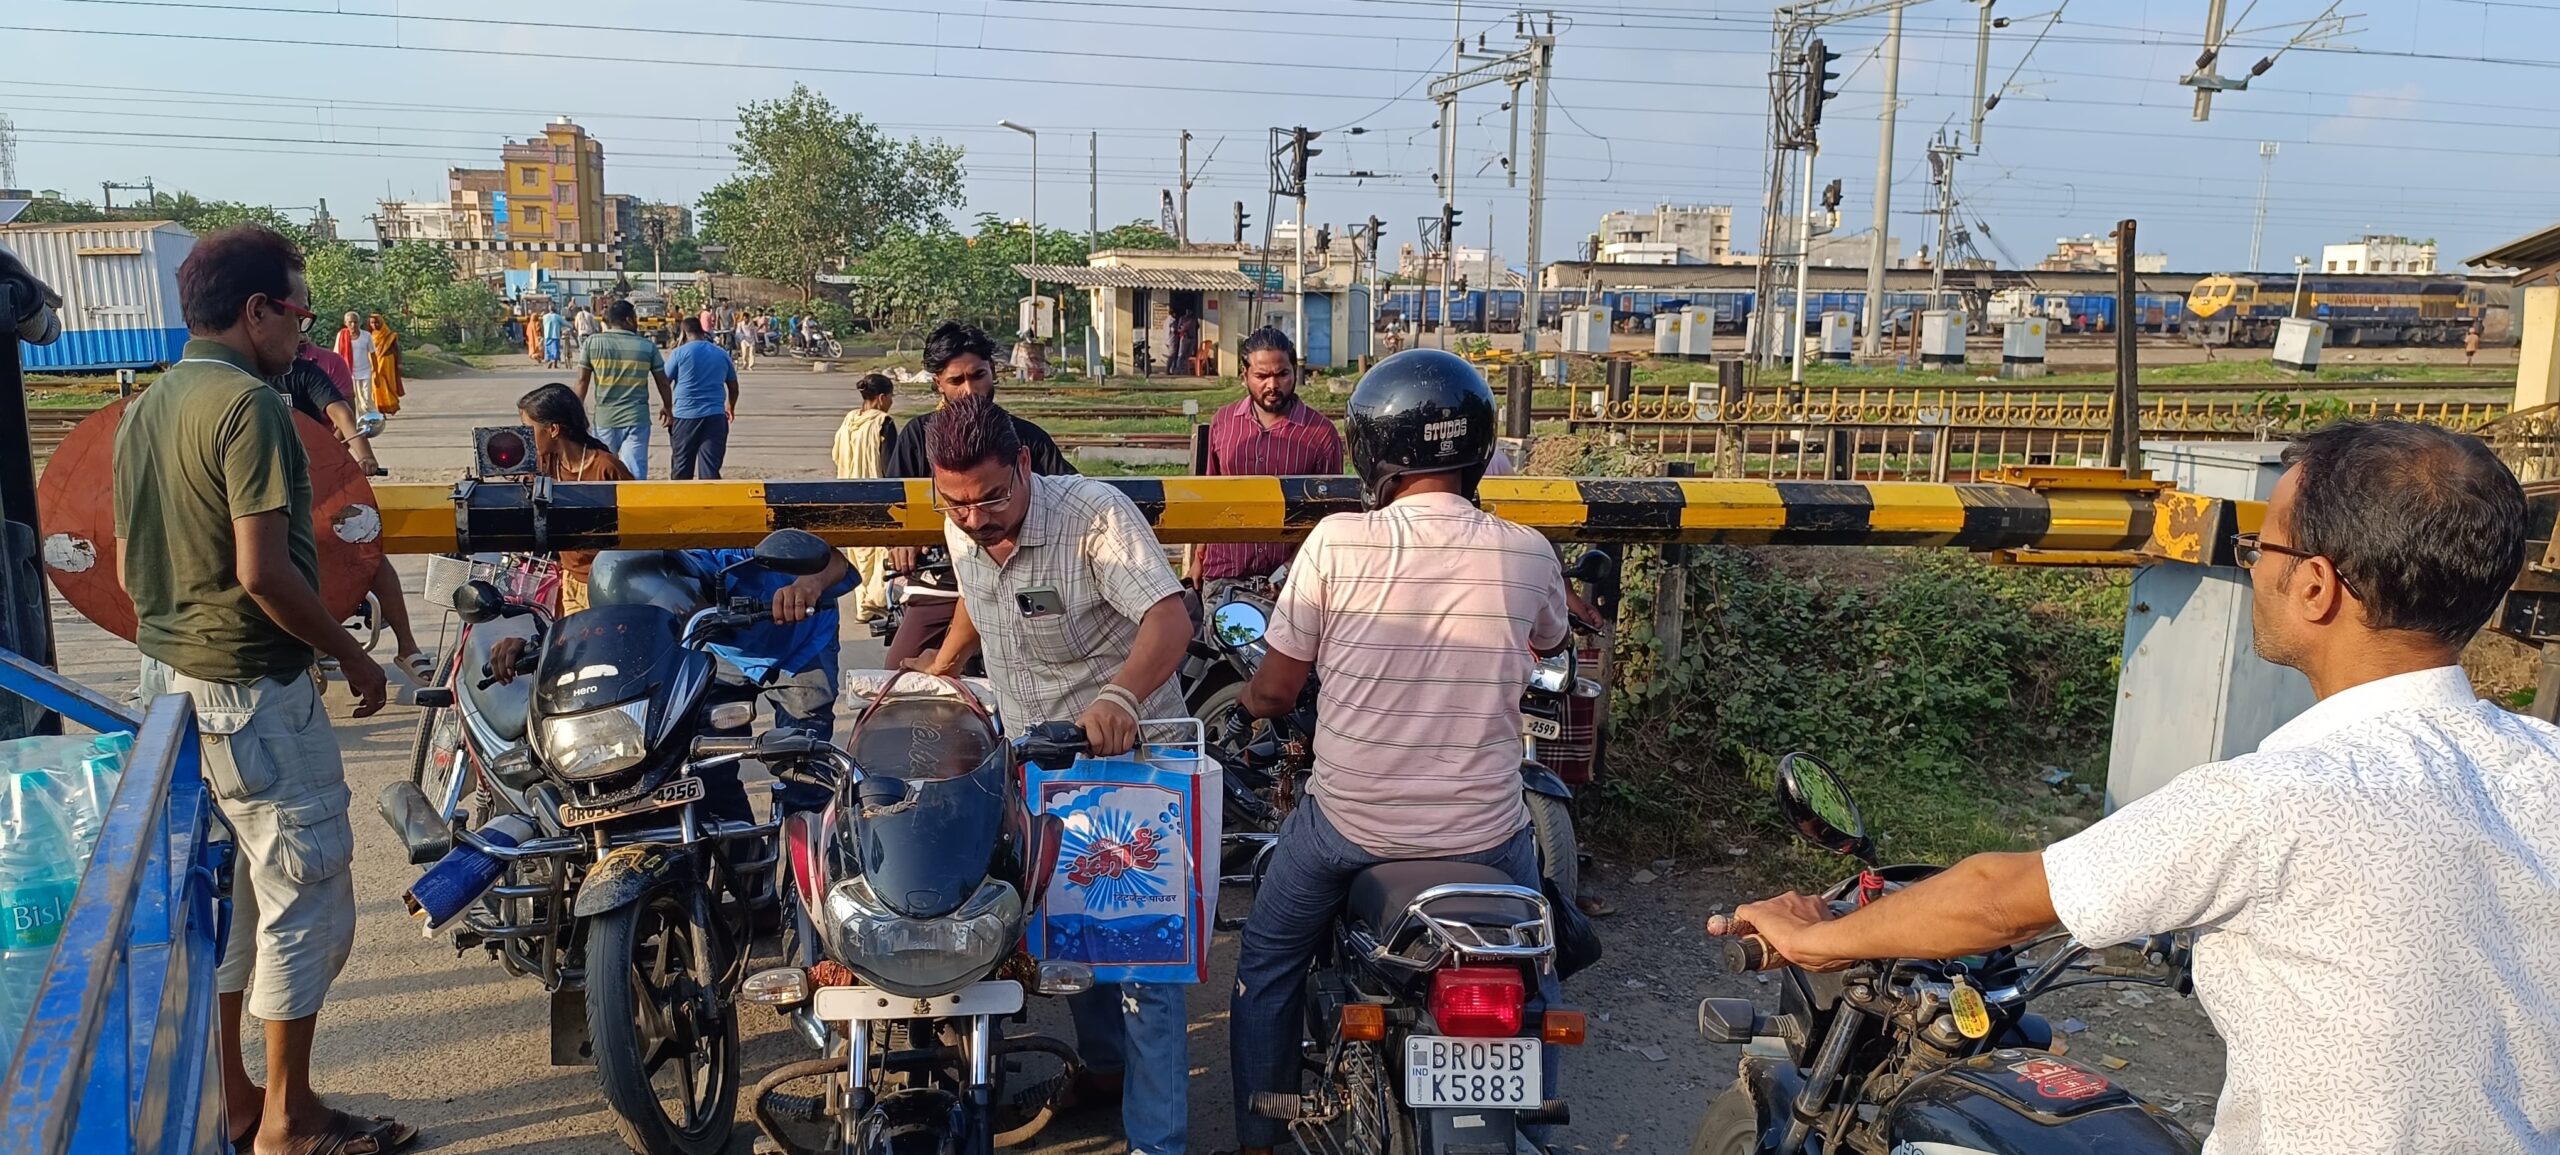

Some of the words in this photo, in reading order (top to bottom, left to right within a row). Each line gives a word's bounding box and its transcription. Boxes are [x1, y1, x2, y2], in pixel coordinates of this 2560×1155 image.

[1424, 417, 1467, 441] STUDDS
[1532, 721, 1556, 736] 2599
[656, 782, 698, 803] 4256
[1149, 894, 1177, 903] पाउडर
[13, 896, 66, 930] Bisl
[1432, 1042, 1524, 1070] BR05B
[1412, 1067, 1429, 1077] IND
[1432, 1074, 1524, 1102] K5883
